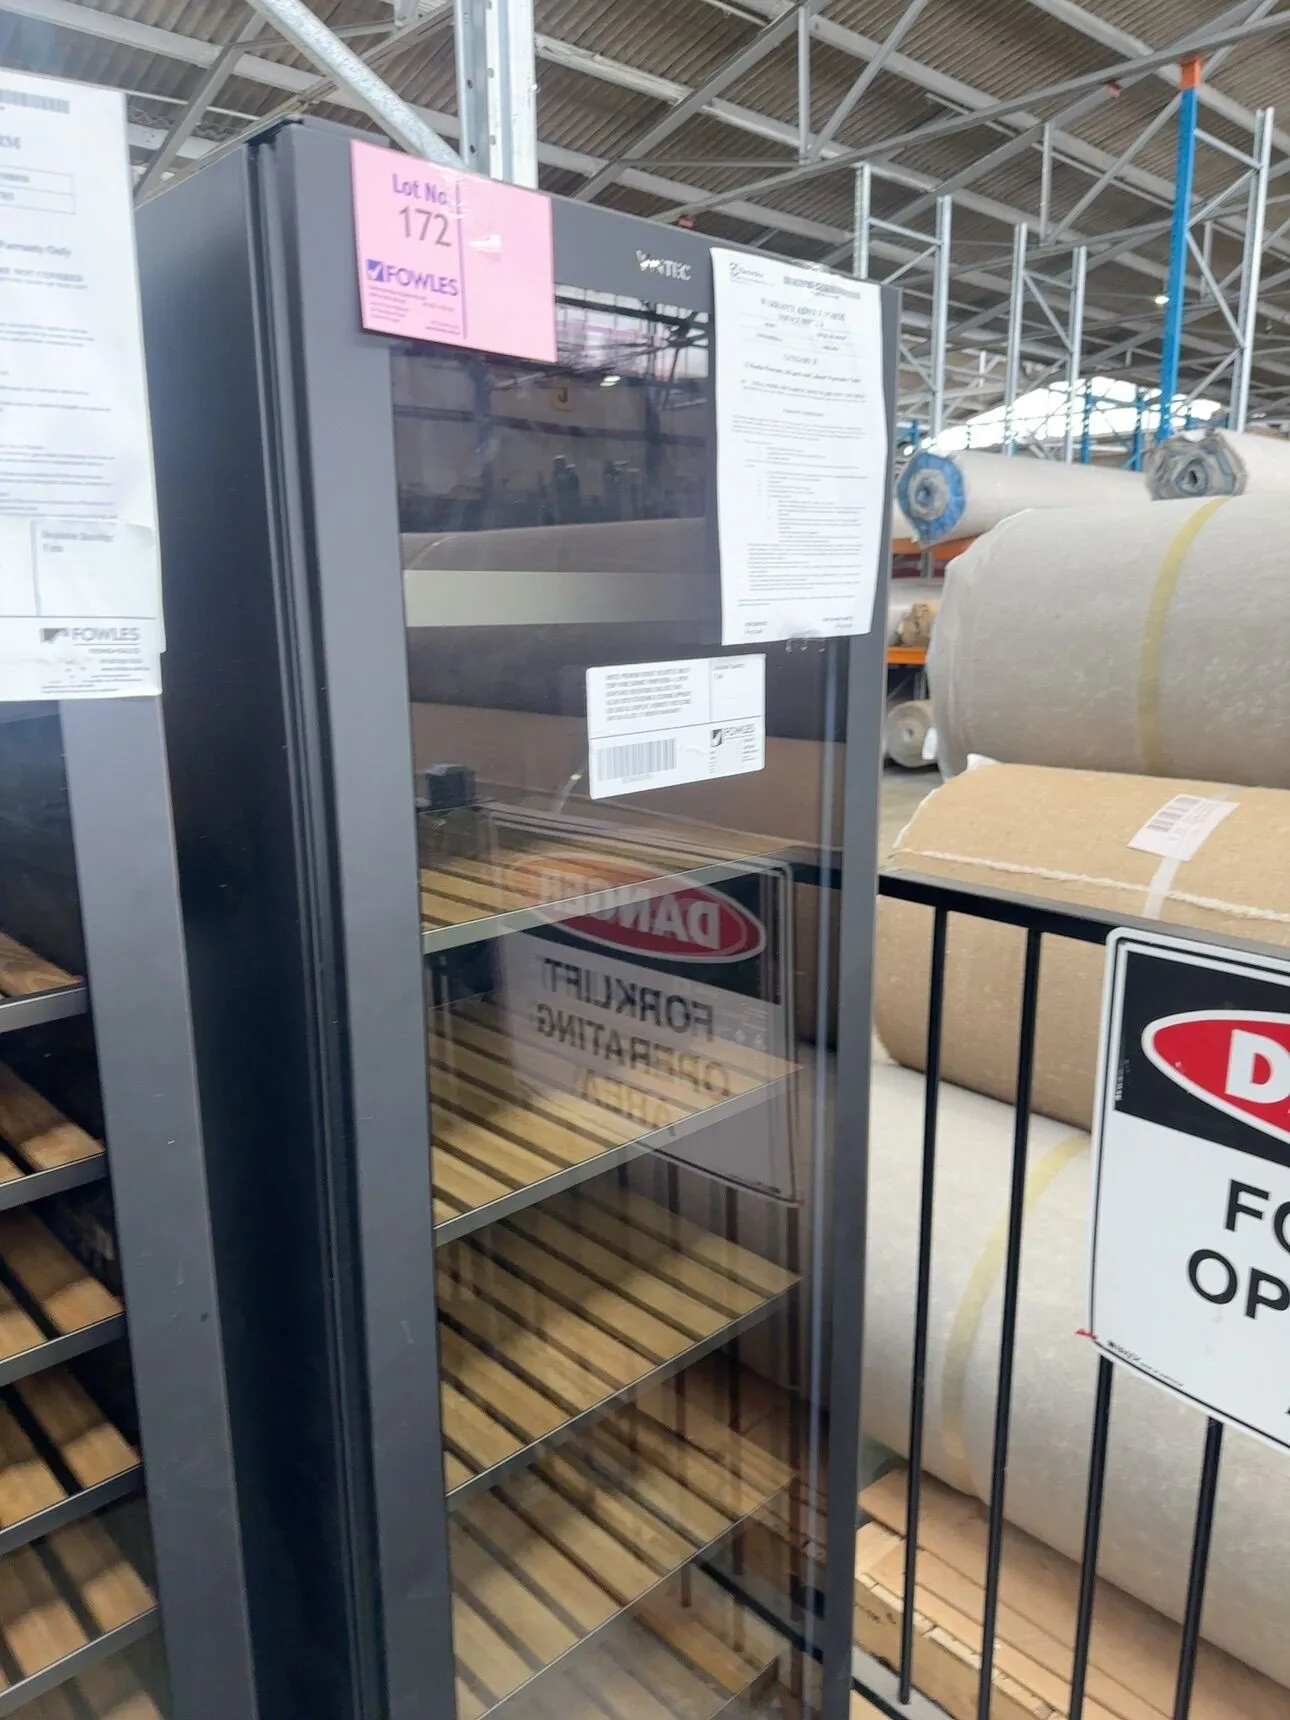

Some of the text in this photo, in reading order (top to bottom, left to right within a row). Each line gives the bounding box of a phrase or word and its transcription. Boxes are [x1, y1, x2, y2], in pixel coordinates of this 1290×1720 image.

[392, 173, 422, 198] Lot
[398, 205, 453, 247] 172
[385, 264, 459, 297] FOWLES
[71, 626, 141, 642] FOWLES
